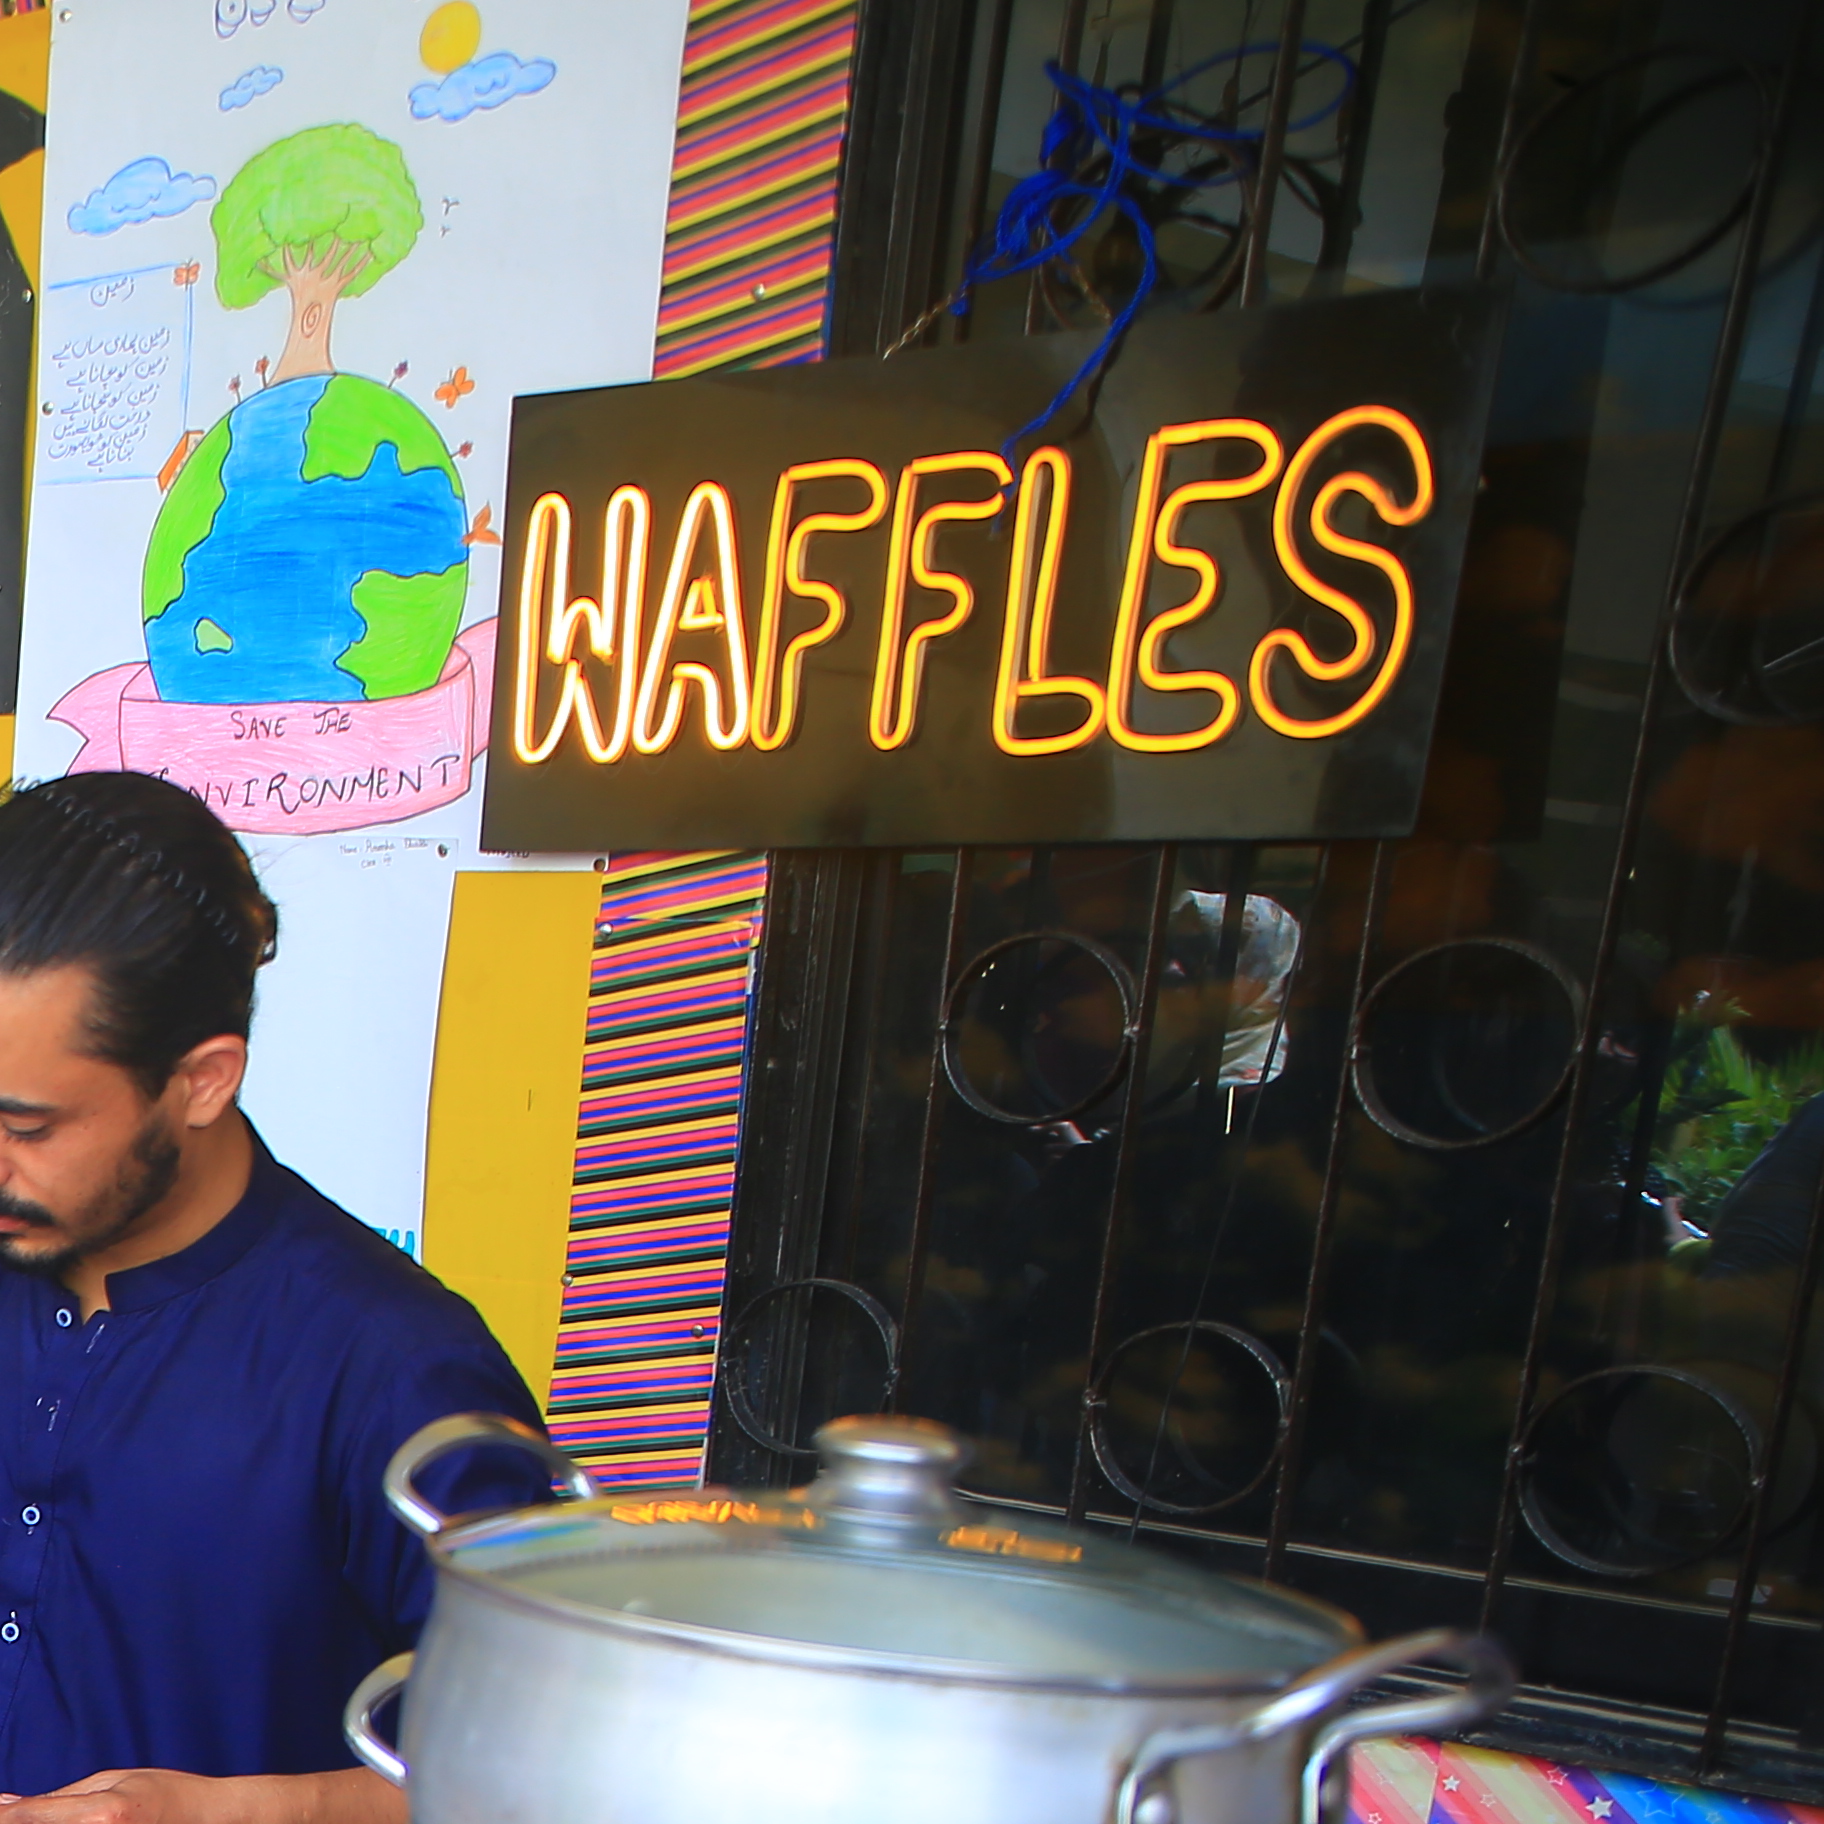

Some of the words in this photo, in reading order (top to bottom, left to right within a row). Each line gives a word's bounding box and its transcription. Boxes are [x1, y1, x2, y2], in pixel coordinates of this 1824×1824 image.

[513, 403, 1434, 765] WAFFLES
[231, 709, 288, 740] SAVE
[313, 706, 352, 736] THE
[148, 754, 461, 815] NVIRONMENT
